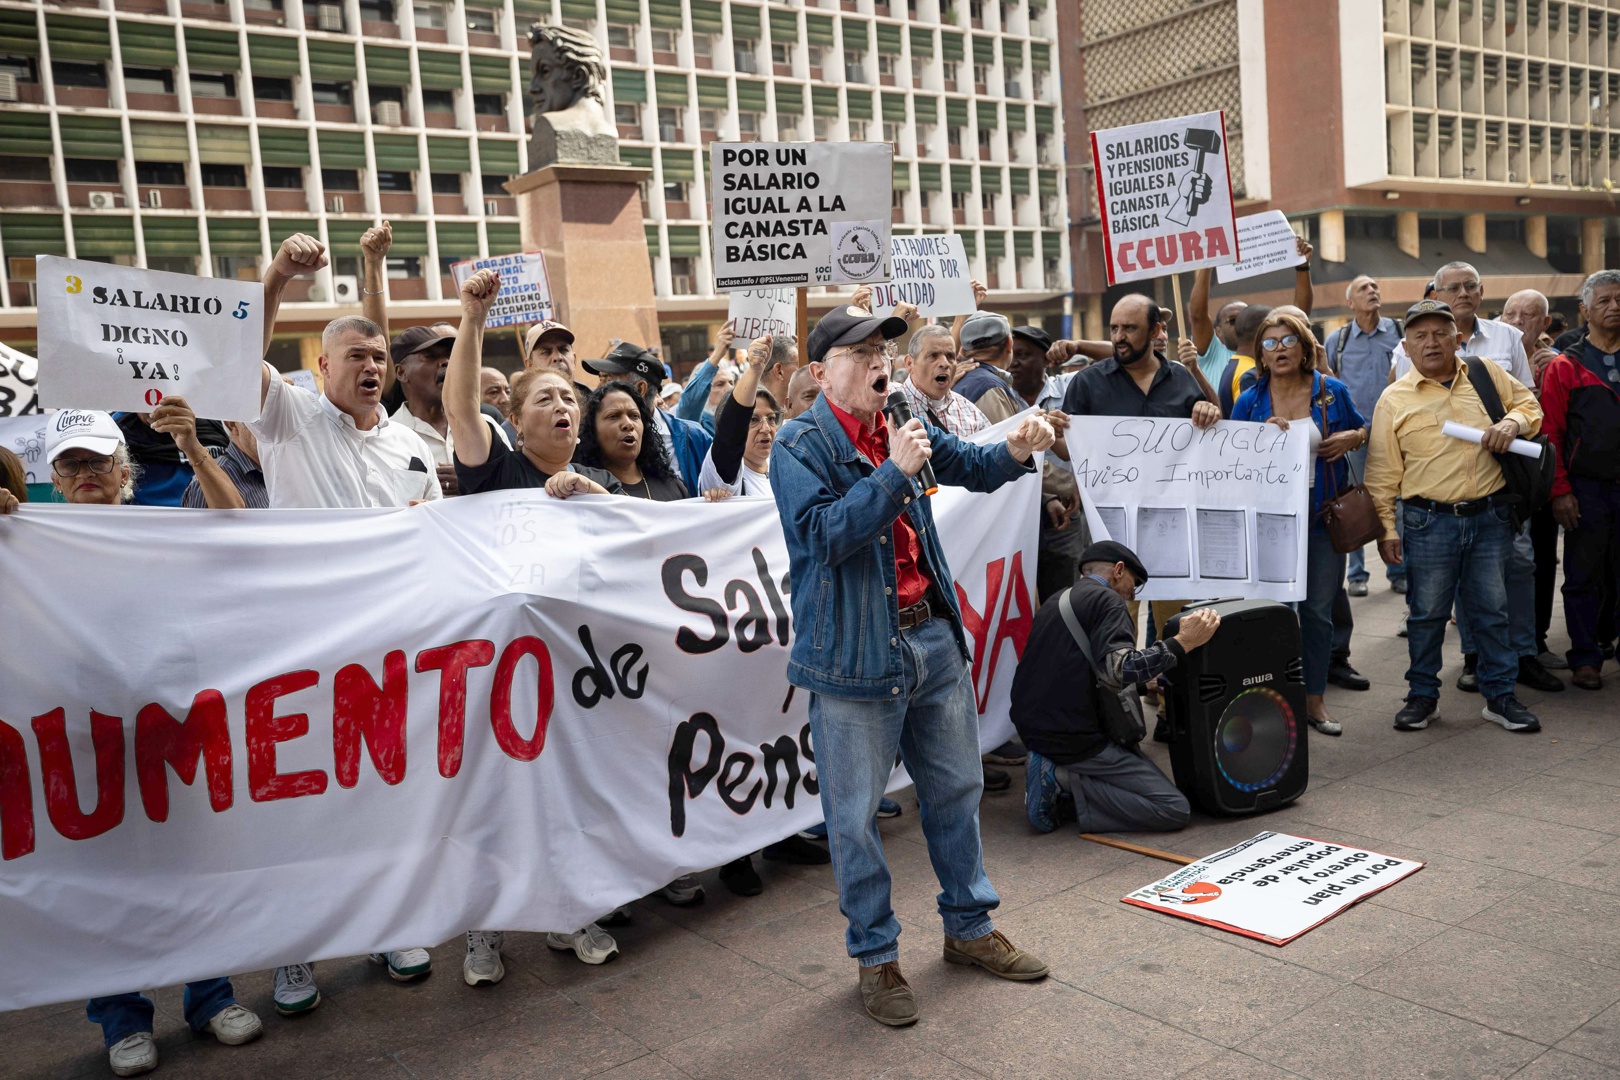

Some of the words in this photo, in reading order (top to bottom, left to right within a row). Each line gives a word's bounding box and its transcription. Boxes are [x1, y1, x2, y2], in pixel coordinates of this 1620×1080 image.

[723, 149, 769, 166] POR
[776, 149, 807, 166] UN
[1105, 133, 1180, 161] SALARIOS
[1107, 164, 1116, 179] Y
[1118, 152, 1190, 177] PENSIONES
[723, 172, 820, 191] SALARIO
[1109, 173, 1165, 197] IGUALES
[1167, 172, 1177, 187] A
[724, 196, 790, 215] IGUAL
[796, 196, 812, 213] A
[819, 195, 846, 212] LA
[1111, 193, 1170, 216] CANASTA
[724, 219, 828, 239] CANASTA
[1112, 213, 1160, 235] BÁSICA
[726, 240, 807, 263] BÁSICA
[892, 237, 950, 256] AJADORES
[1117, 226, 1230, 273] CCURA
[718, 279, 755, 287] laclase.info
[759, 274, 807, 284] @PSLVenezuela
[891, 258, 935, 280] HAMOS
[940, 259, 960, 279] POR
[66, 275, 82, 294] 3
[93, 286, 222, 315] SALARIO
[232, 301, 250, 319] 5
[875, 282, 935, 308] DIGNIDAD
[487, 301, 552, 317] DECAMARAS
[101, 324, 188, 347] DIGNO
[733, 317, 792, 340] LIBERTAD
[661, 546, 792, 656] Sal
[954, 550, 1034, 715] YA
[571, 624, 649, 709] de
[1242, 673, 1274, 686] aiwa
[1216, 840, 1315, 885] emergencia
[1278, 845, 1343, 875] popular
[1313, 852, 1369, 878] obrero
[1252, 874, 1280, 887] de
[1297, 876, 1318, 885] y
[1341, 873, 1371, 886] un
[1302, 883, 1347, 906] plan
